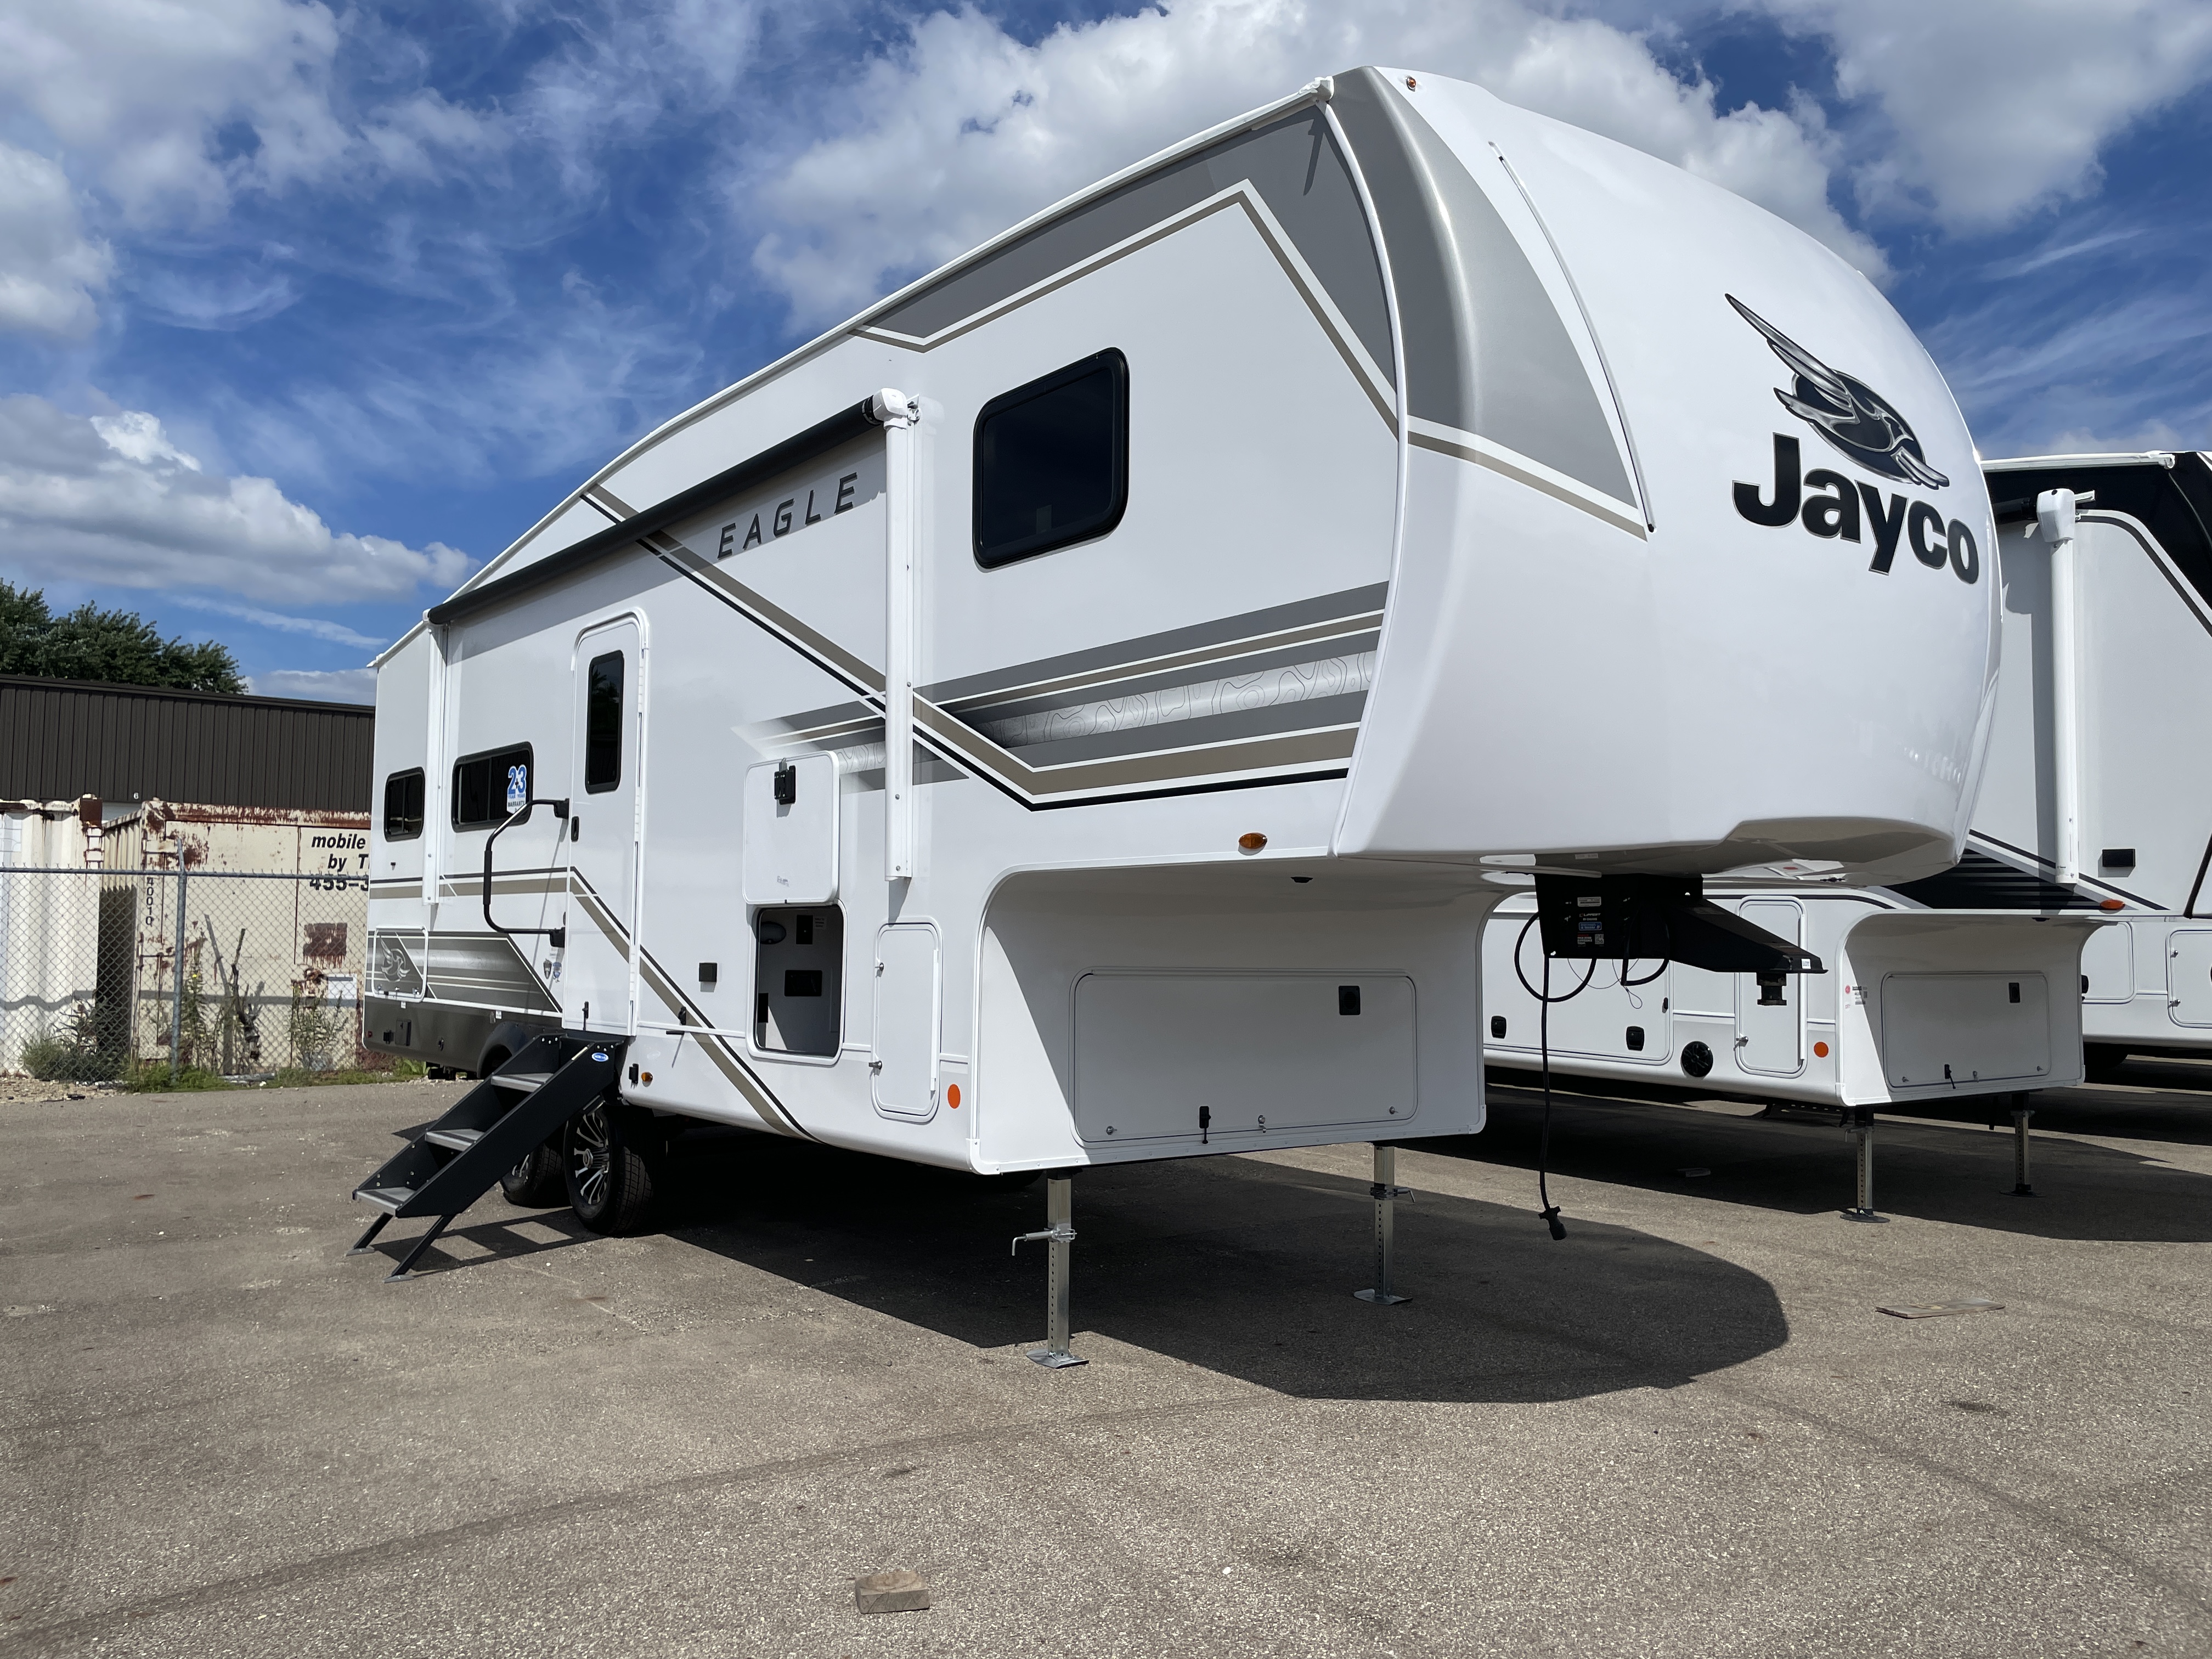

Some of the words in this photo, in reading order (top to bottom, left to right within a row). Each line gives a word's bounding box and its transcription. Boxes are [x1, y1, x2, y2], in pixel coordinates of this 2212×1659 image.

[717, 472, 857, 560] EAGLE
[1732, 432, 1979, 584] Jayco
[312, 833, 366, 849] mobile
[328, 854, 347, 872] by
[358, 854, 369, 869] T
